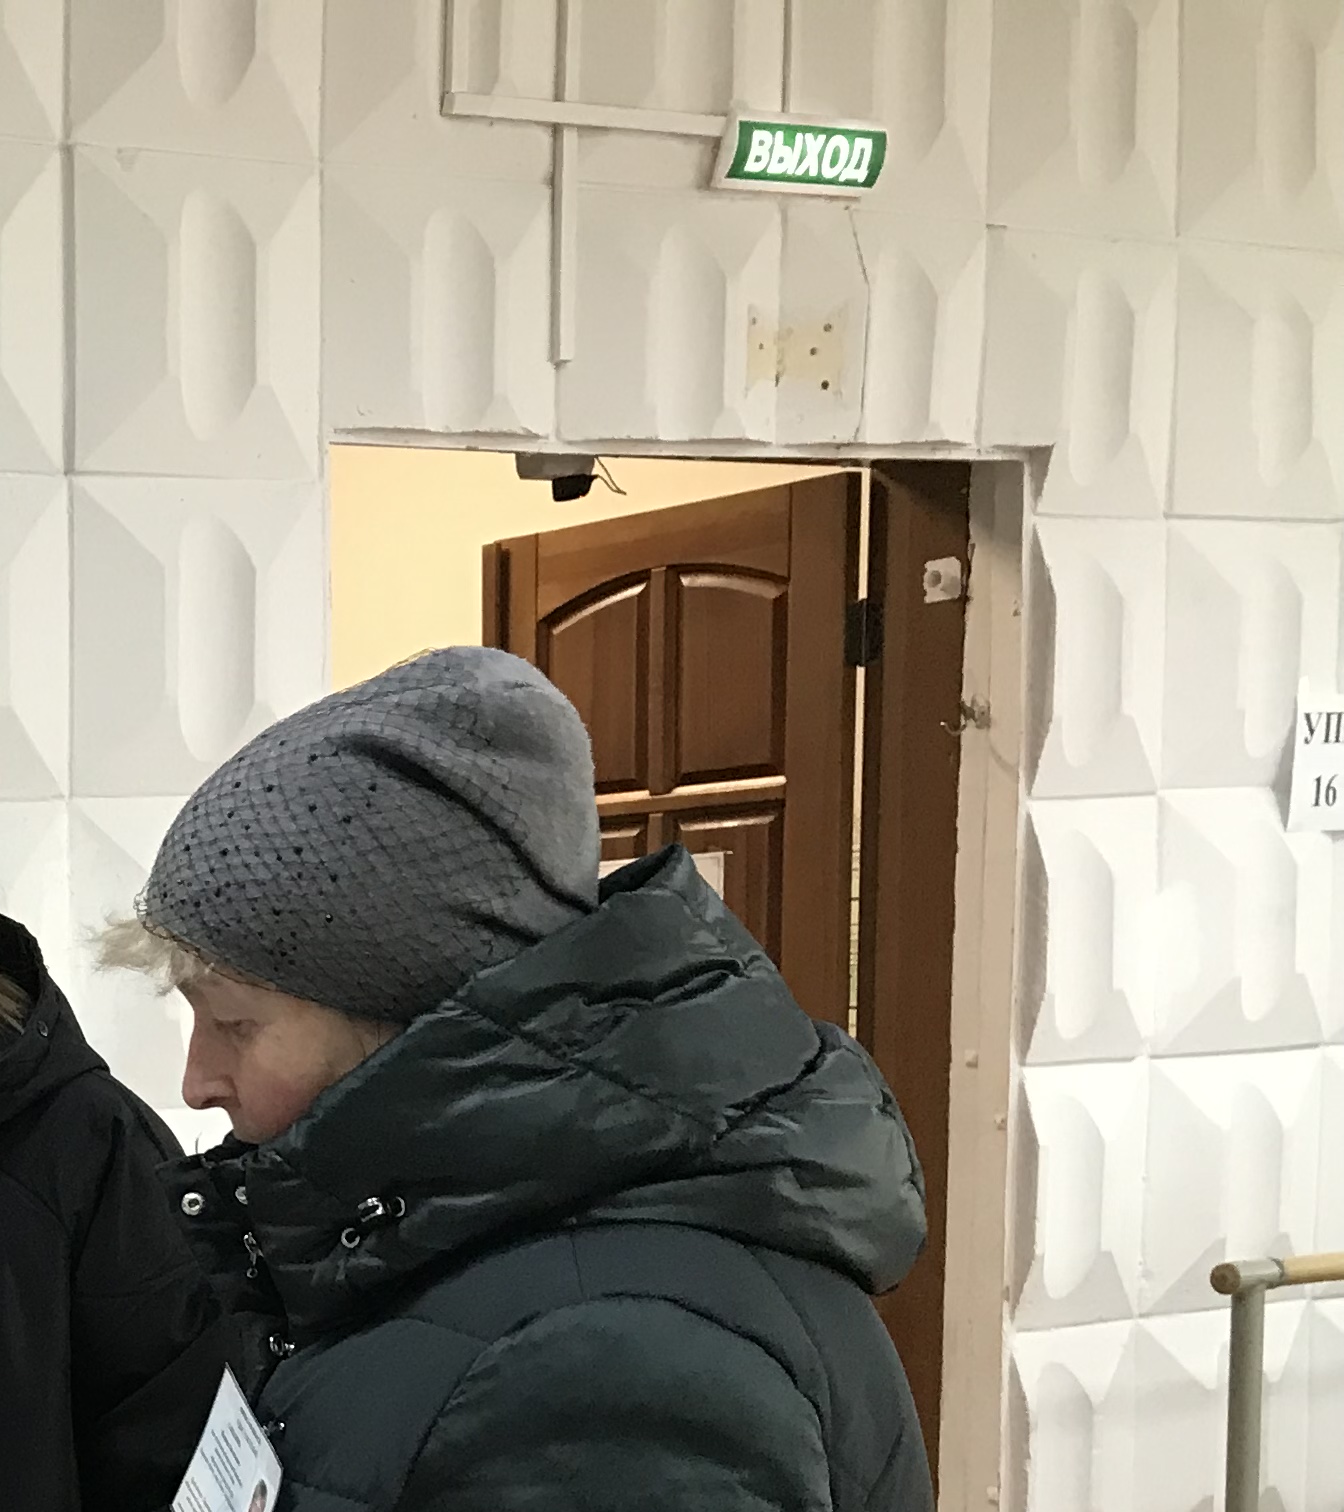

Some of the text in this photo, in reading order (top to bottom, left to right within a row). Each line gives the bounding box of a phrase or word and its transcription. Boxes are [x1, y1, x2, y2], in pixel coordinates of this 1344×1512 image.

[744, 129, 873, 183] ВЫХОД
[1303, 711, 1344, 744] УП
[1312, 774, 1338, 807] 16
